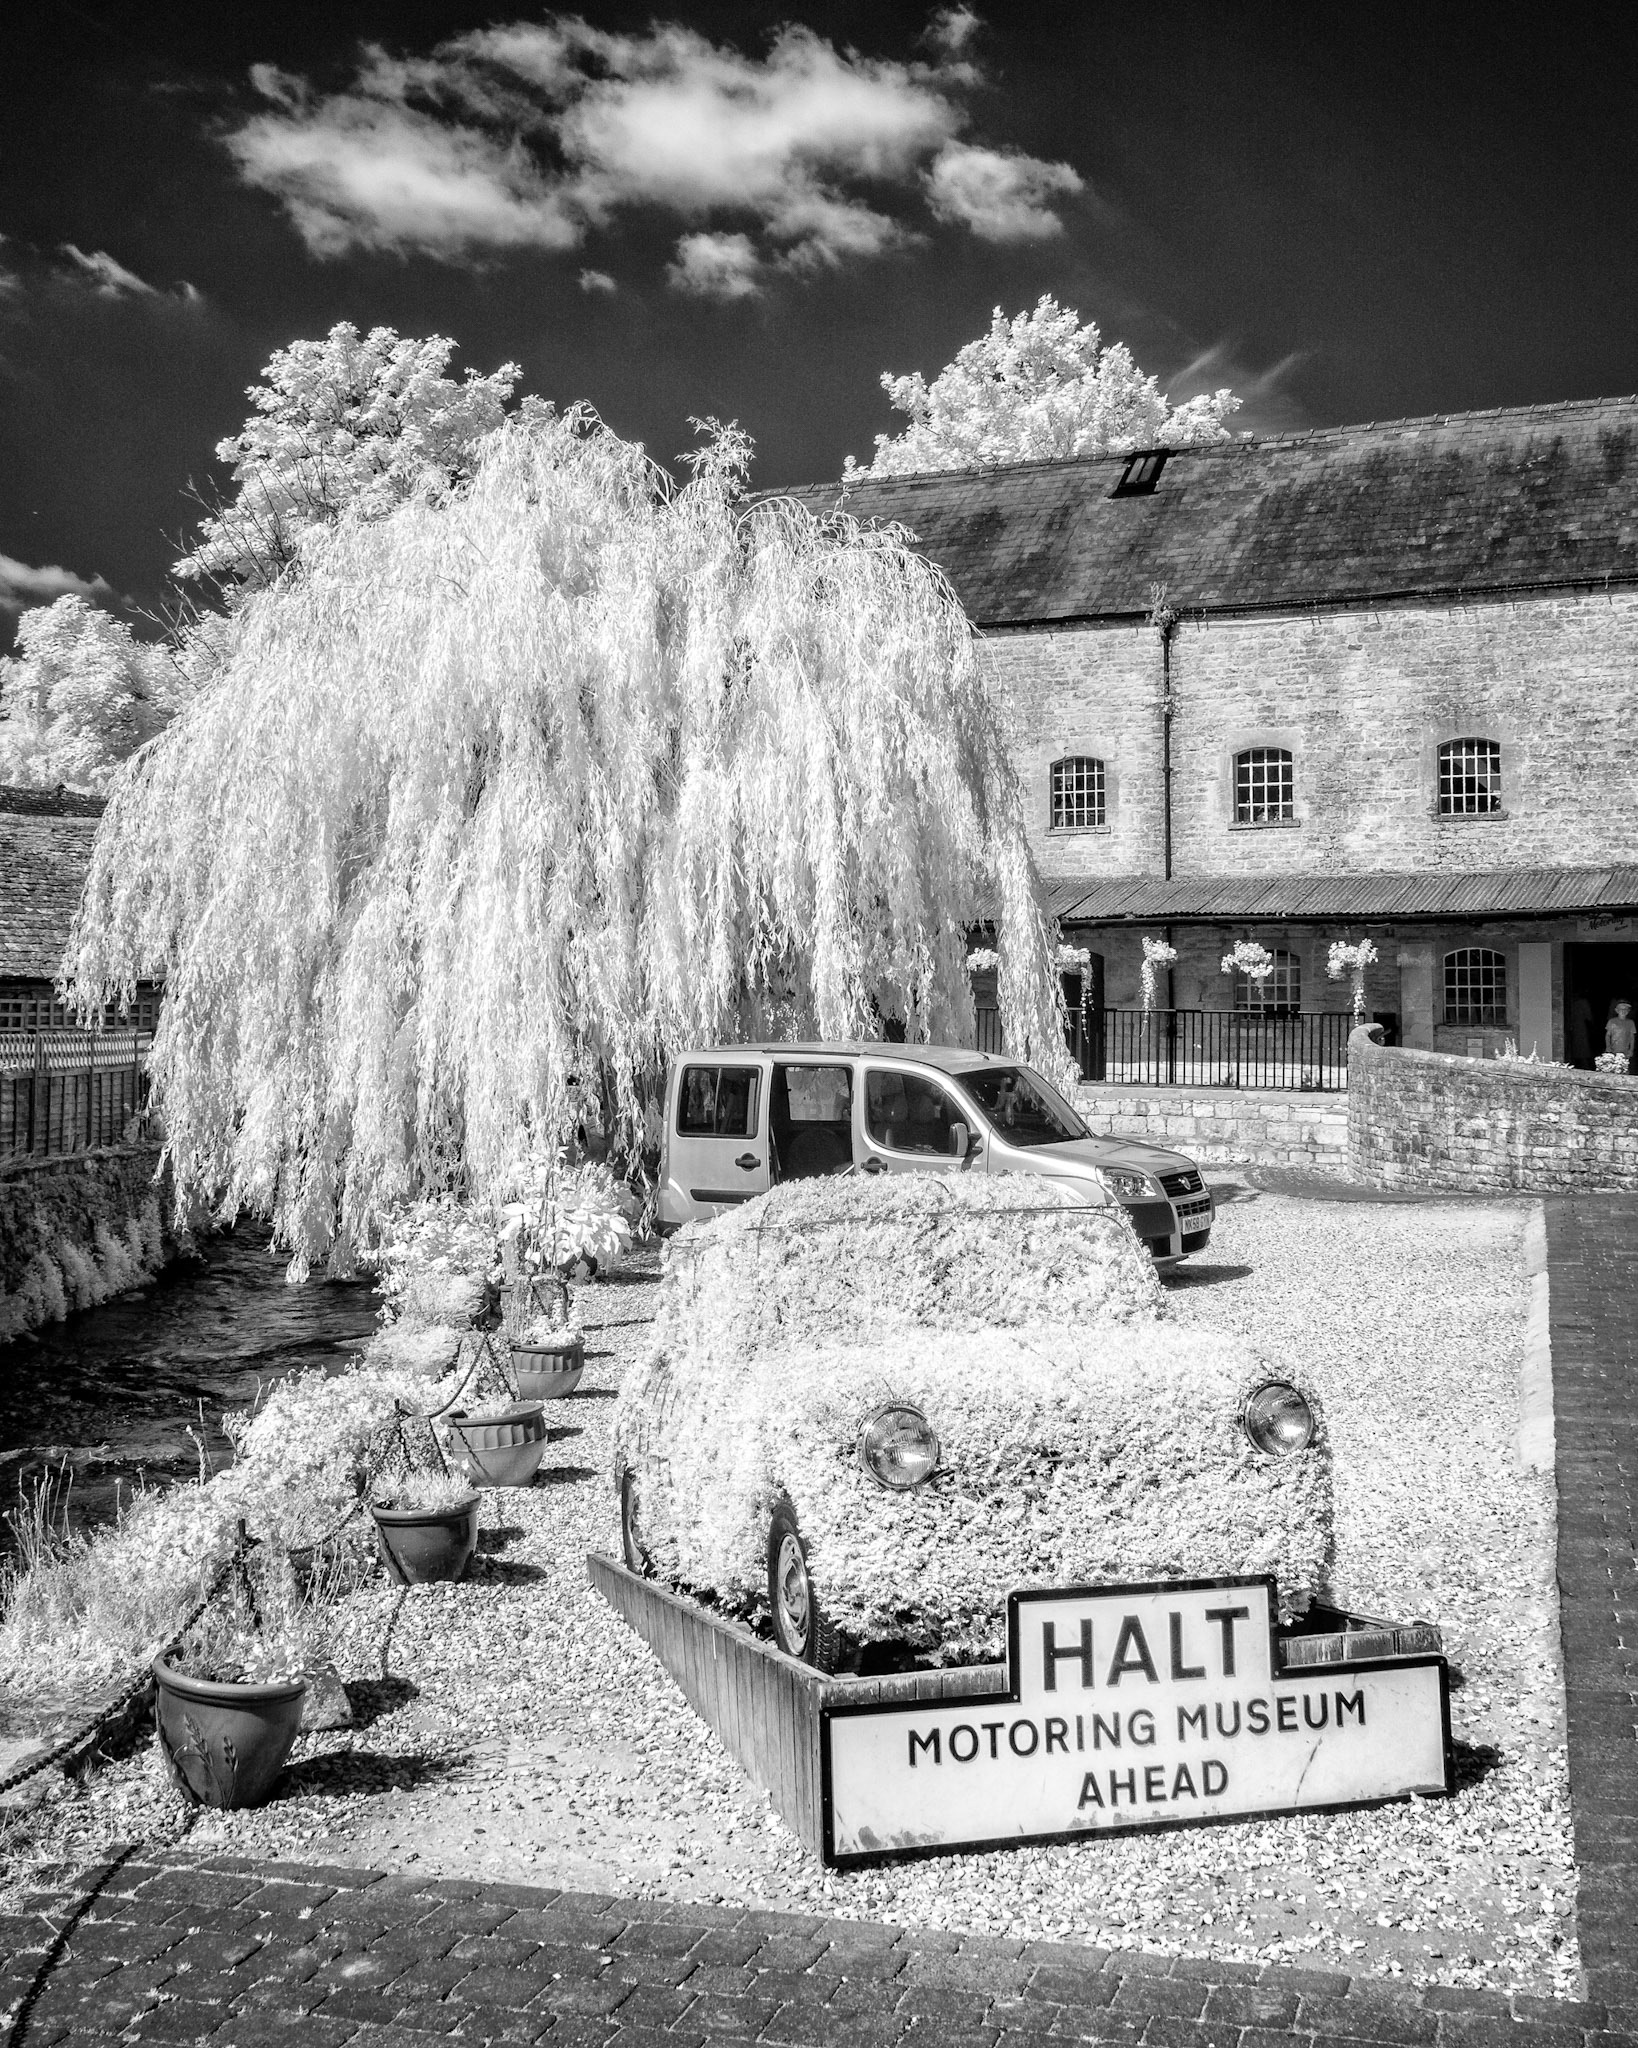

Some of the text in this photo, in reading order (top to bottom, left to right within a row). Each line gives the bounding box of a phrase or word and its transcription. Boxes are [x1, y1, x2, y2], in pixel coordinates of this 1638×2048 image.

[1042, 1606, 1249, 1693] HALT
[908, 1689, 1367, 1768] MOTORING MUSEUM
[1077, 1760, 1229, 1810] AHEAD
